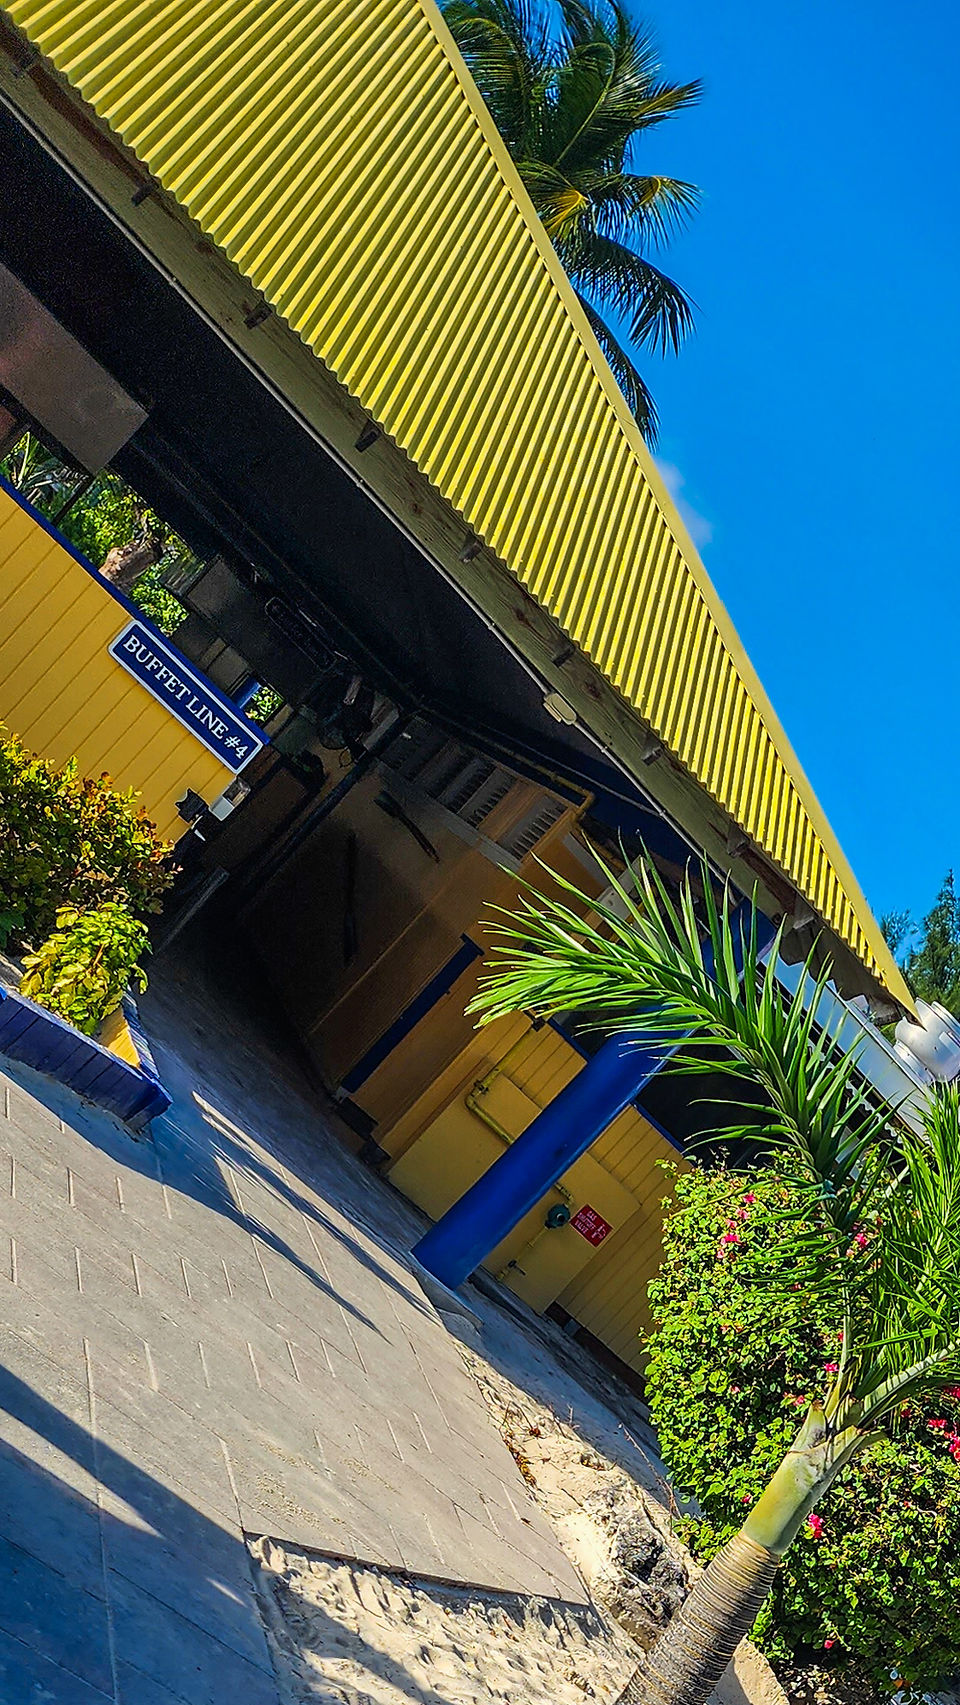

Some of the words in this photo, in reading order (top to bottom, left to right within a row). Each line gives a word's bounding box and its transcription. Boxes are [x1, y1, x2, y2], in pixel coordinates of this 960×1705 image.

[122, 634, 192, 701] BUFFET
[185, 695, 229, 740] LINE
[223, 735, 249, 760] #4
